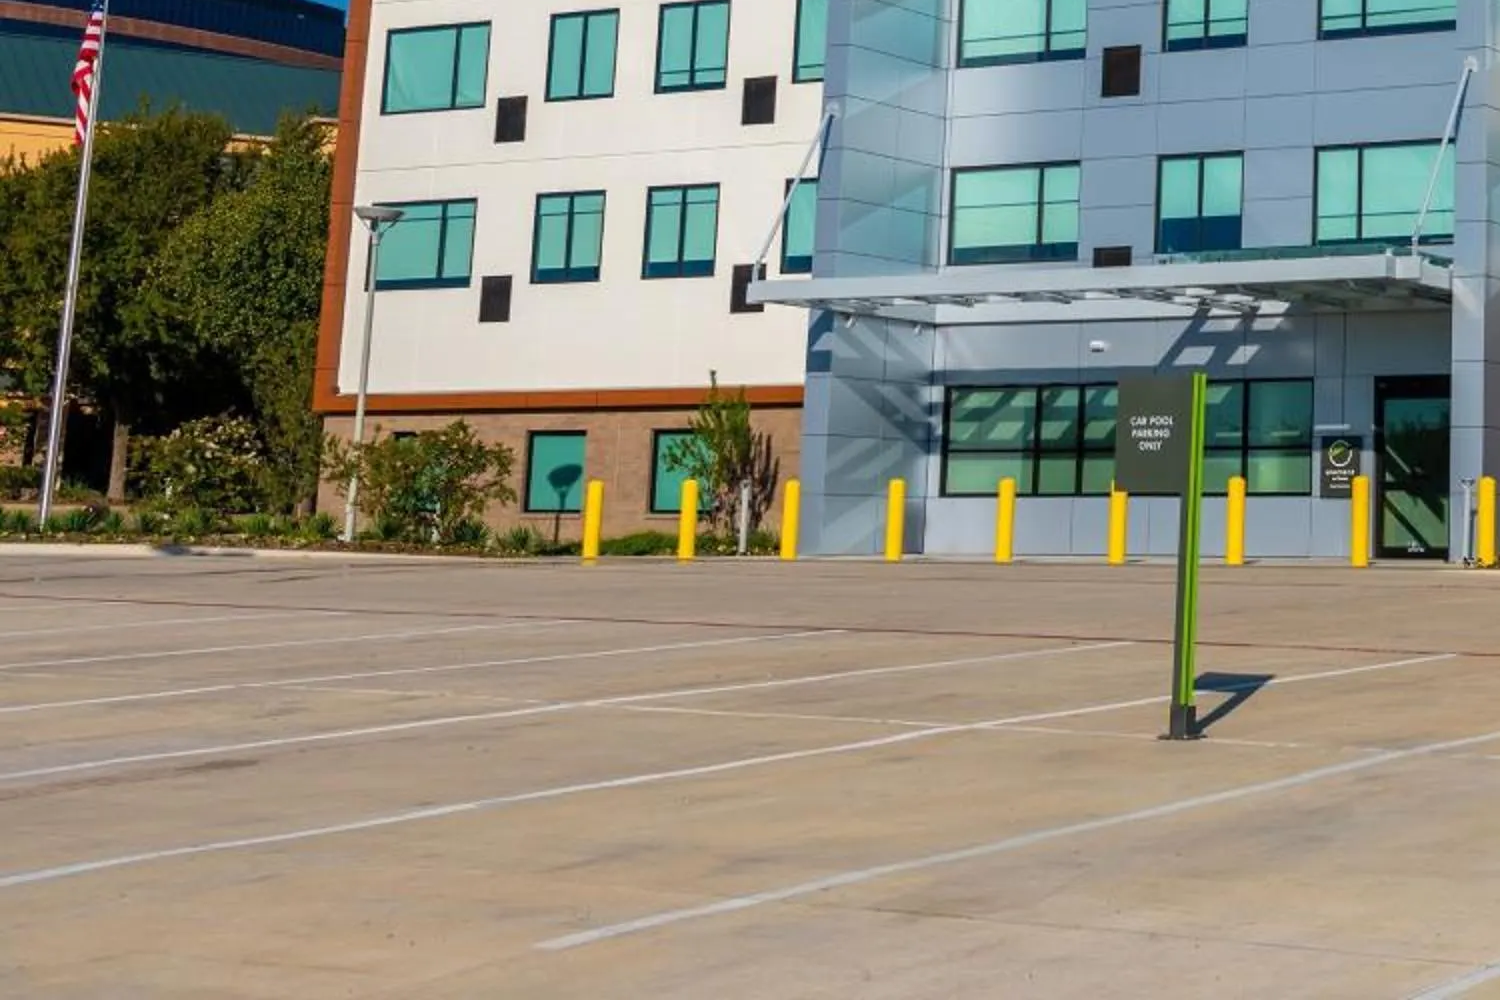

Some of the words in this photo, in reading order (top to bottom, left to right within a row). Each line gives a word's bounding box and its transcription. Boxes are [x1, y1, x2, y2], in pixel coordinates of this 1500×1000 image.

[1130, 415, 1147, 426] CAR
[1149, 415, 1173, 426] POOL
[1131, 428, 1170, 439] PARKING
[1138, 440, 1163, 451] ONLY
